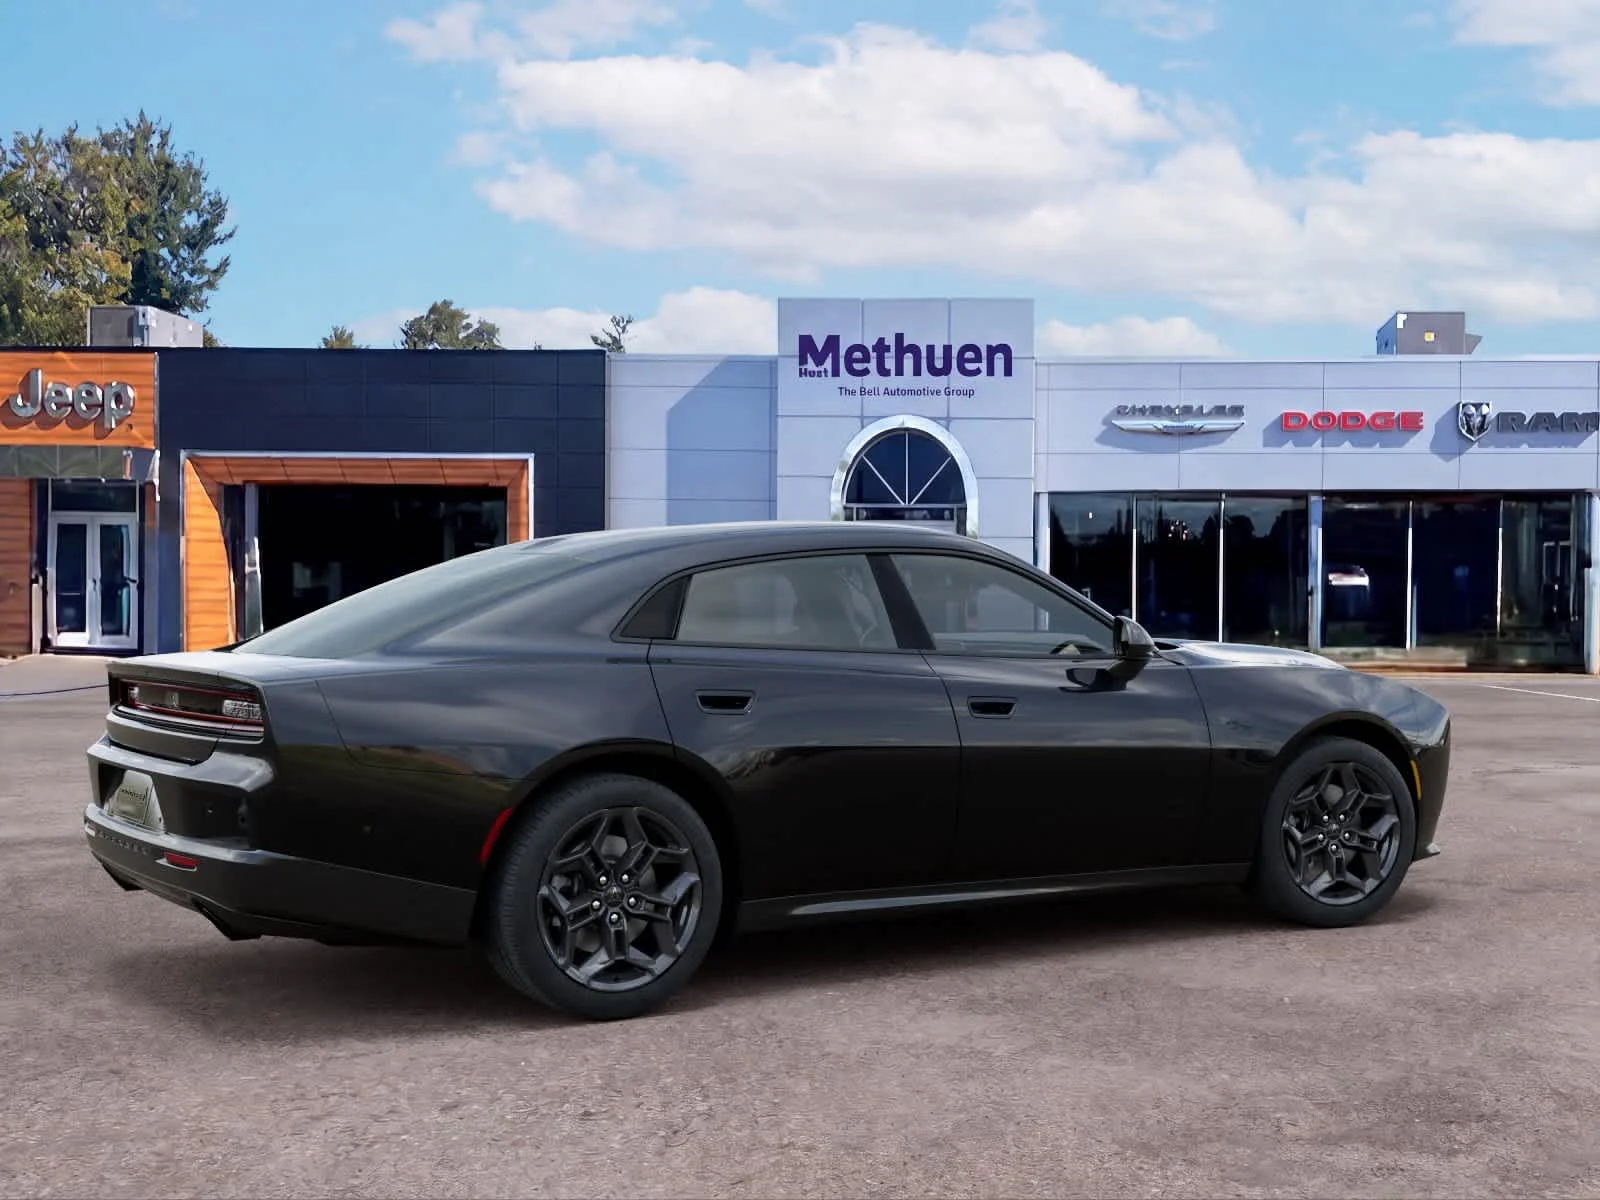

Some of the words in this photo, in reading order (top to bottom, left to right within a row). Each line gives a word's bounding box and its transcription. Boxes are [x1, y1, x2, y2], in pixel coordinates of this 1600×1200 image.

[798, 333, 1013, 377] Methuen
[9, 368, 136, 429] Jeep
[838, 386, 857, 397] The
[860, 386, 880, 397] Bell
[883, 386, 942, 397] Automotive
[944, 386, 976, 399] Group
[1281, 411, 1424, 432] DODGE
[1496, 411, 1600, 433] RAM
